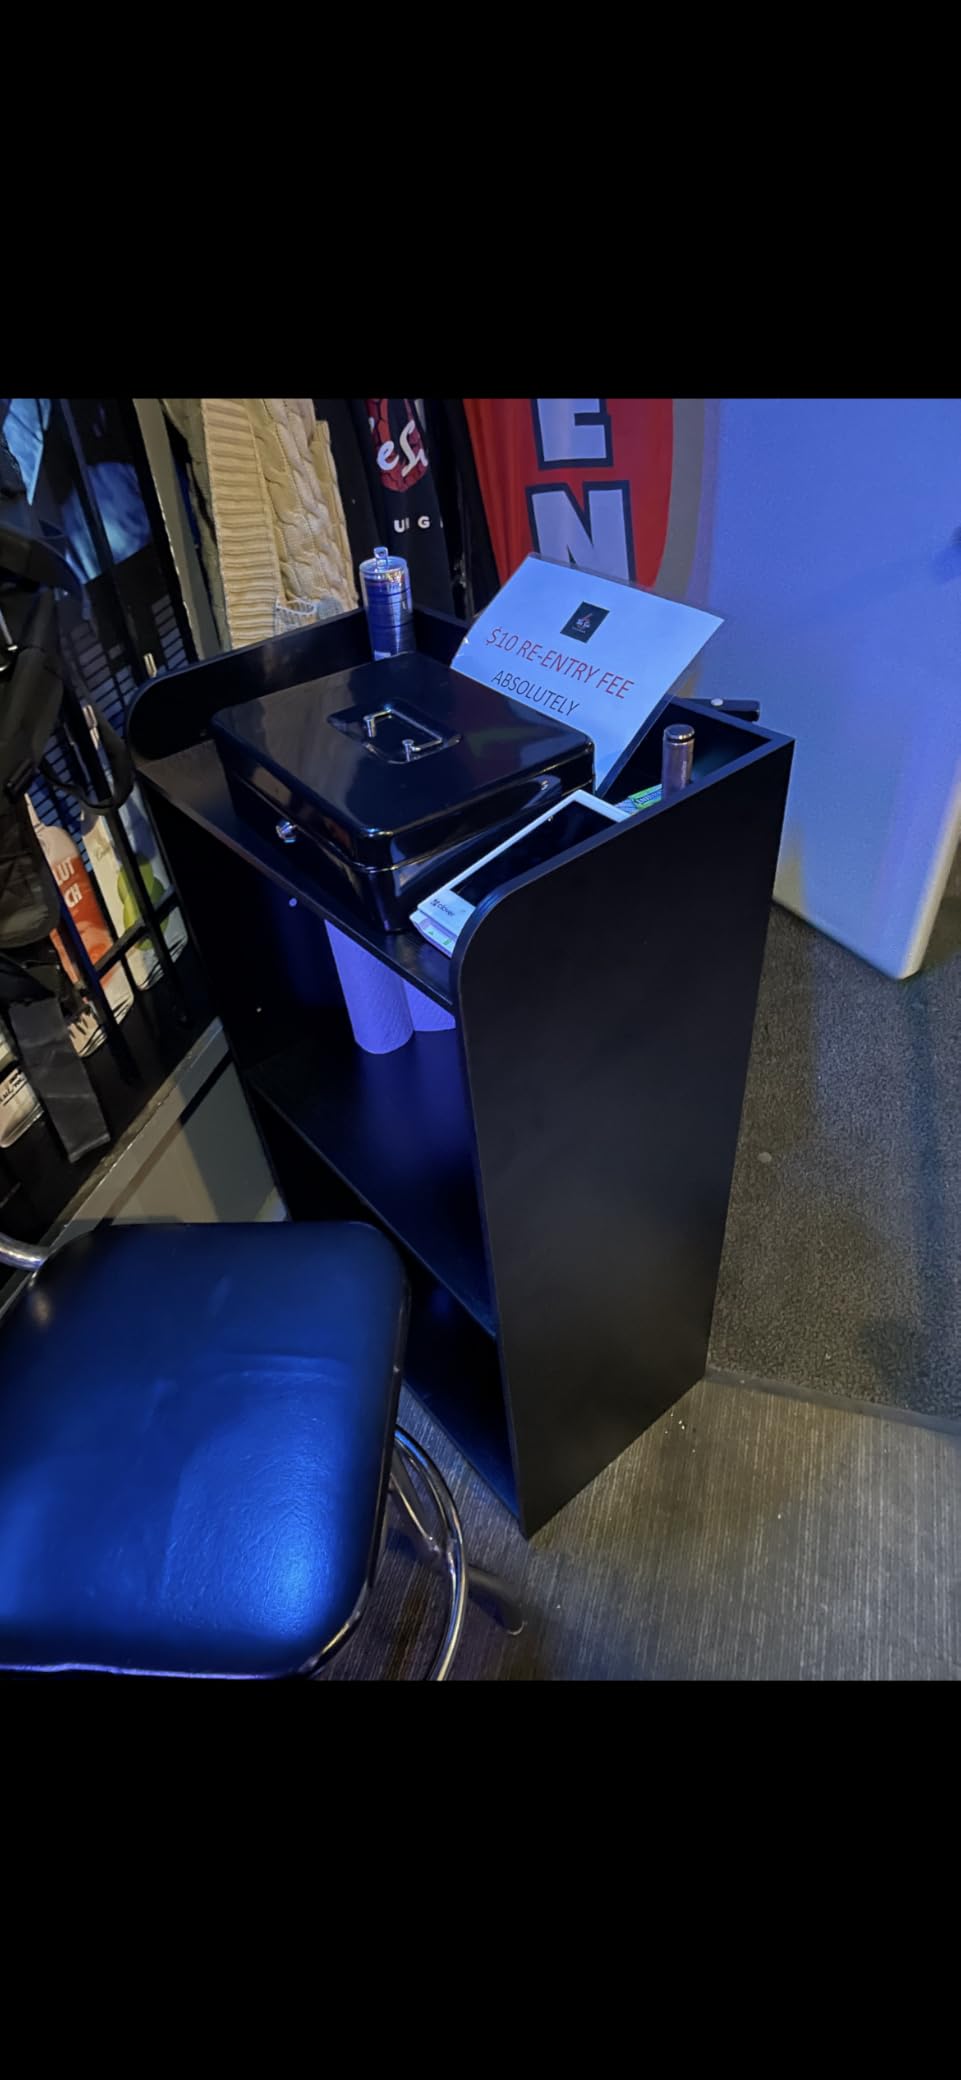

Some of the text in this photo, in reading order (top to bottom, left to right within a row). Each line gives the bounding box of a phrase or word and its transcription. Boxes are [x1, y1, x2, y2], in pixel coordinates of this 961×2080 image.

[486, 627, 635, 699] $10 RE-ENTRY FEE
[491, 670, 580, 716] ABSOLUTELY
